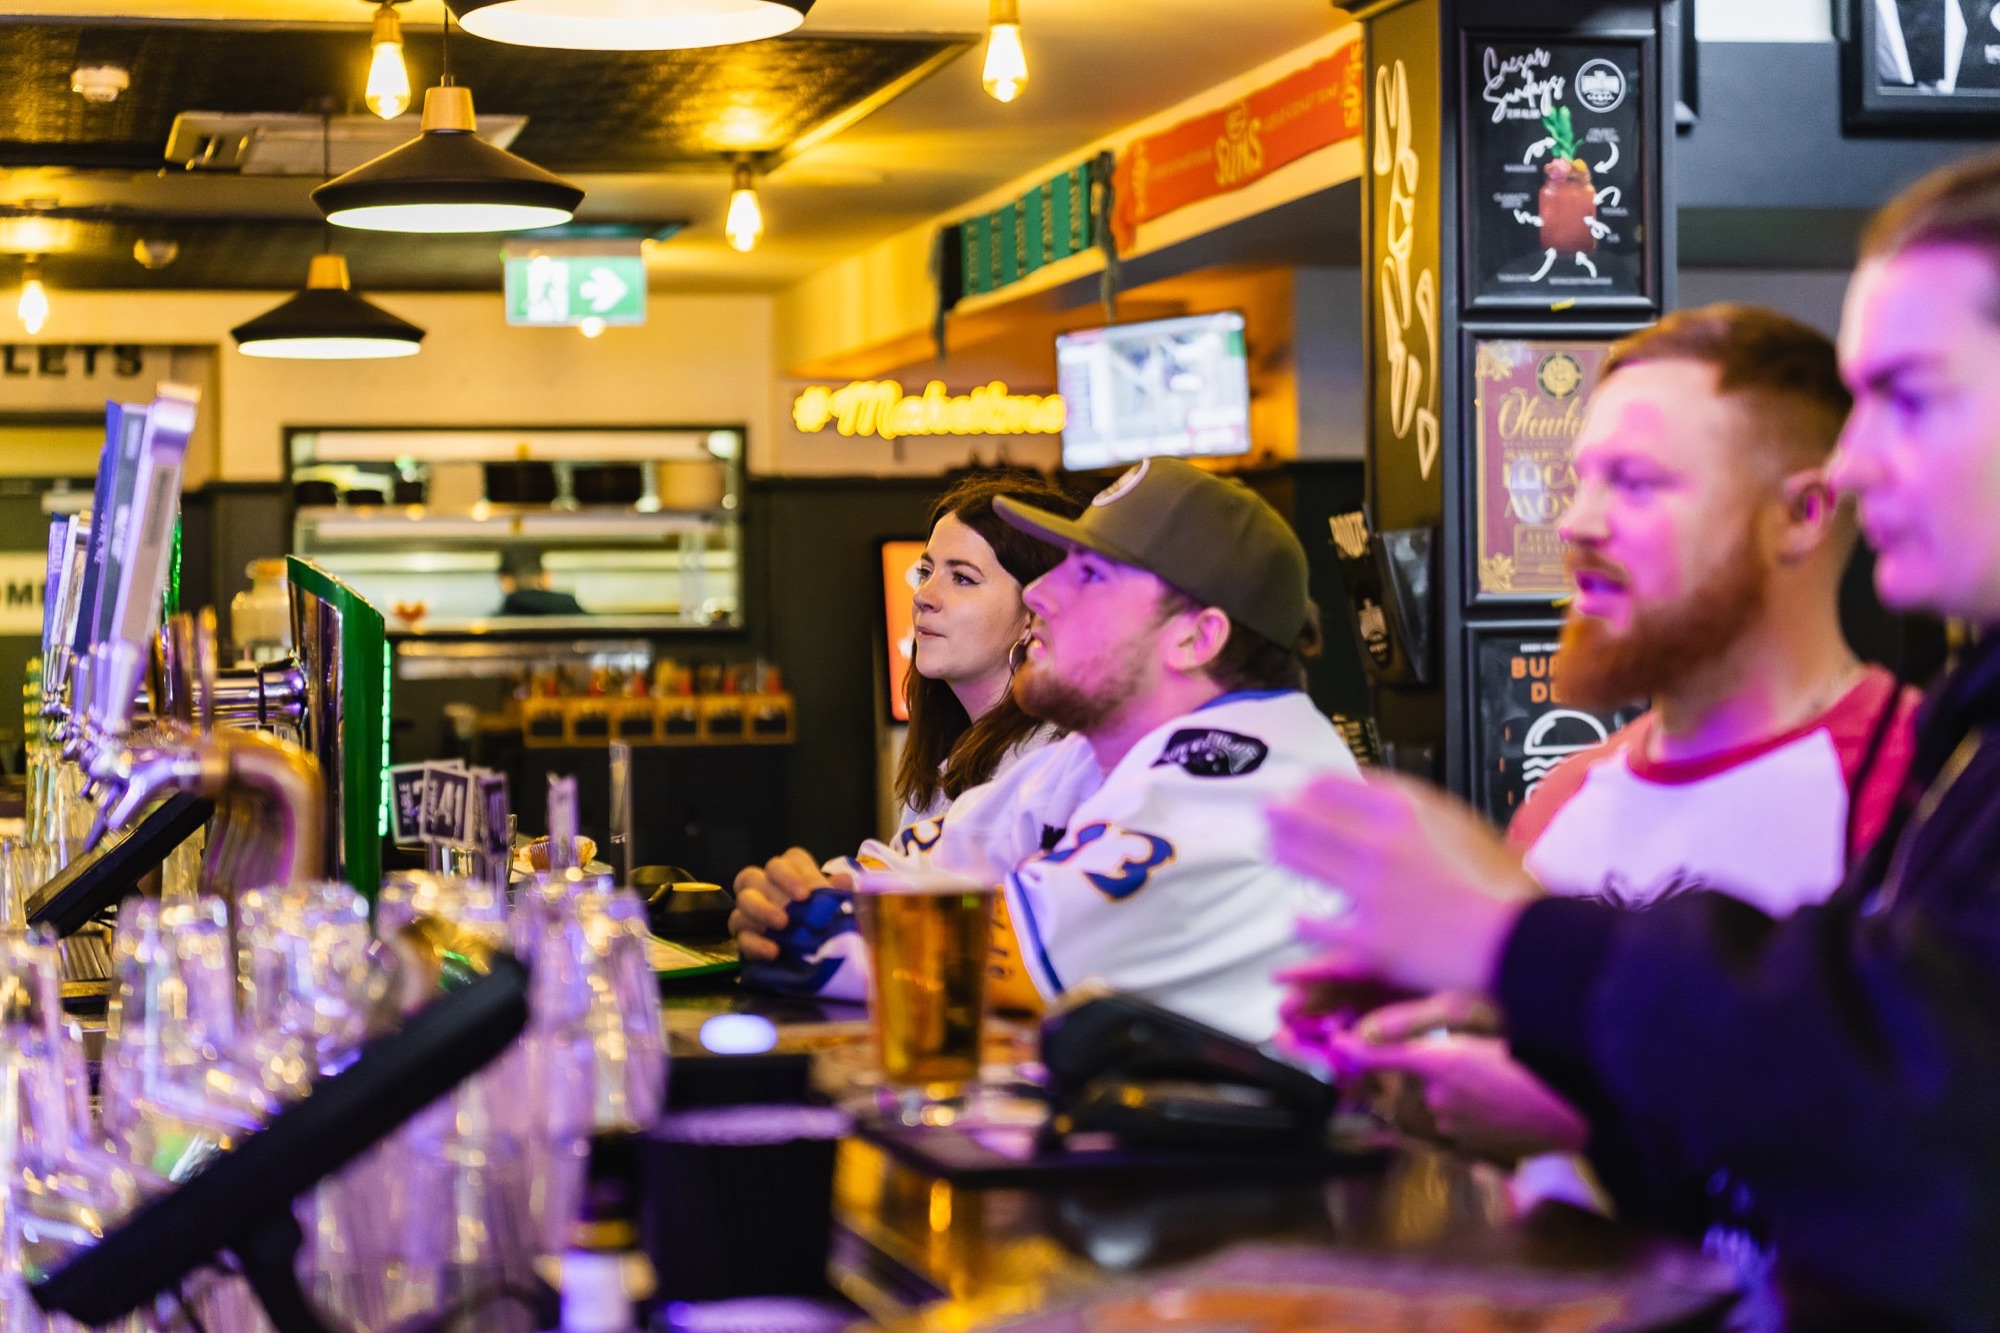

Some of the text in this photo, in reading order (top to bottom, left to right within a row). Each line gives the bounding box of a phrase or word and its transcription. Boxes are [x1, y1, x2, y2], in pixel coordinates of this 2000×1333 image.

[1483, 47, 1551, 90] Caesar
[1482, 70, 1567, 124] Sundays
[1214, 117, 1263, 187] SUNS
